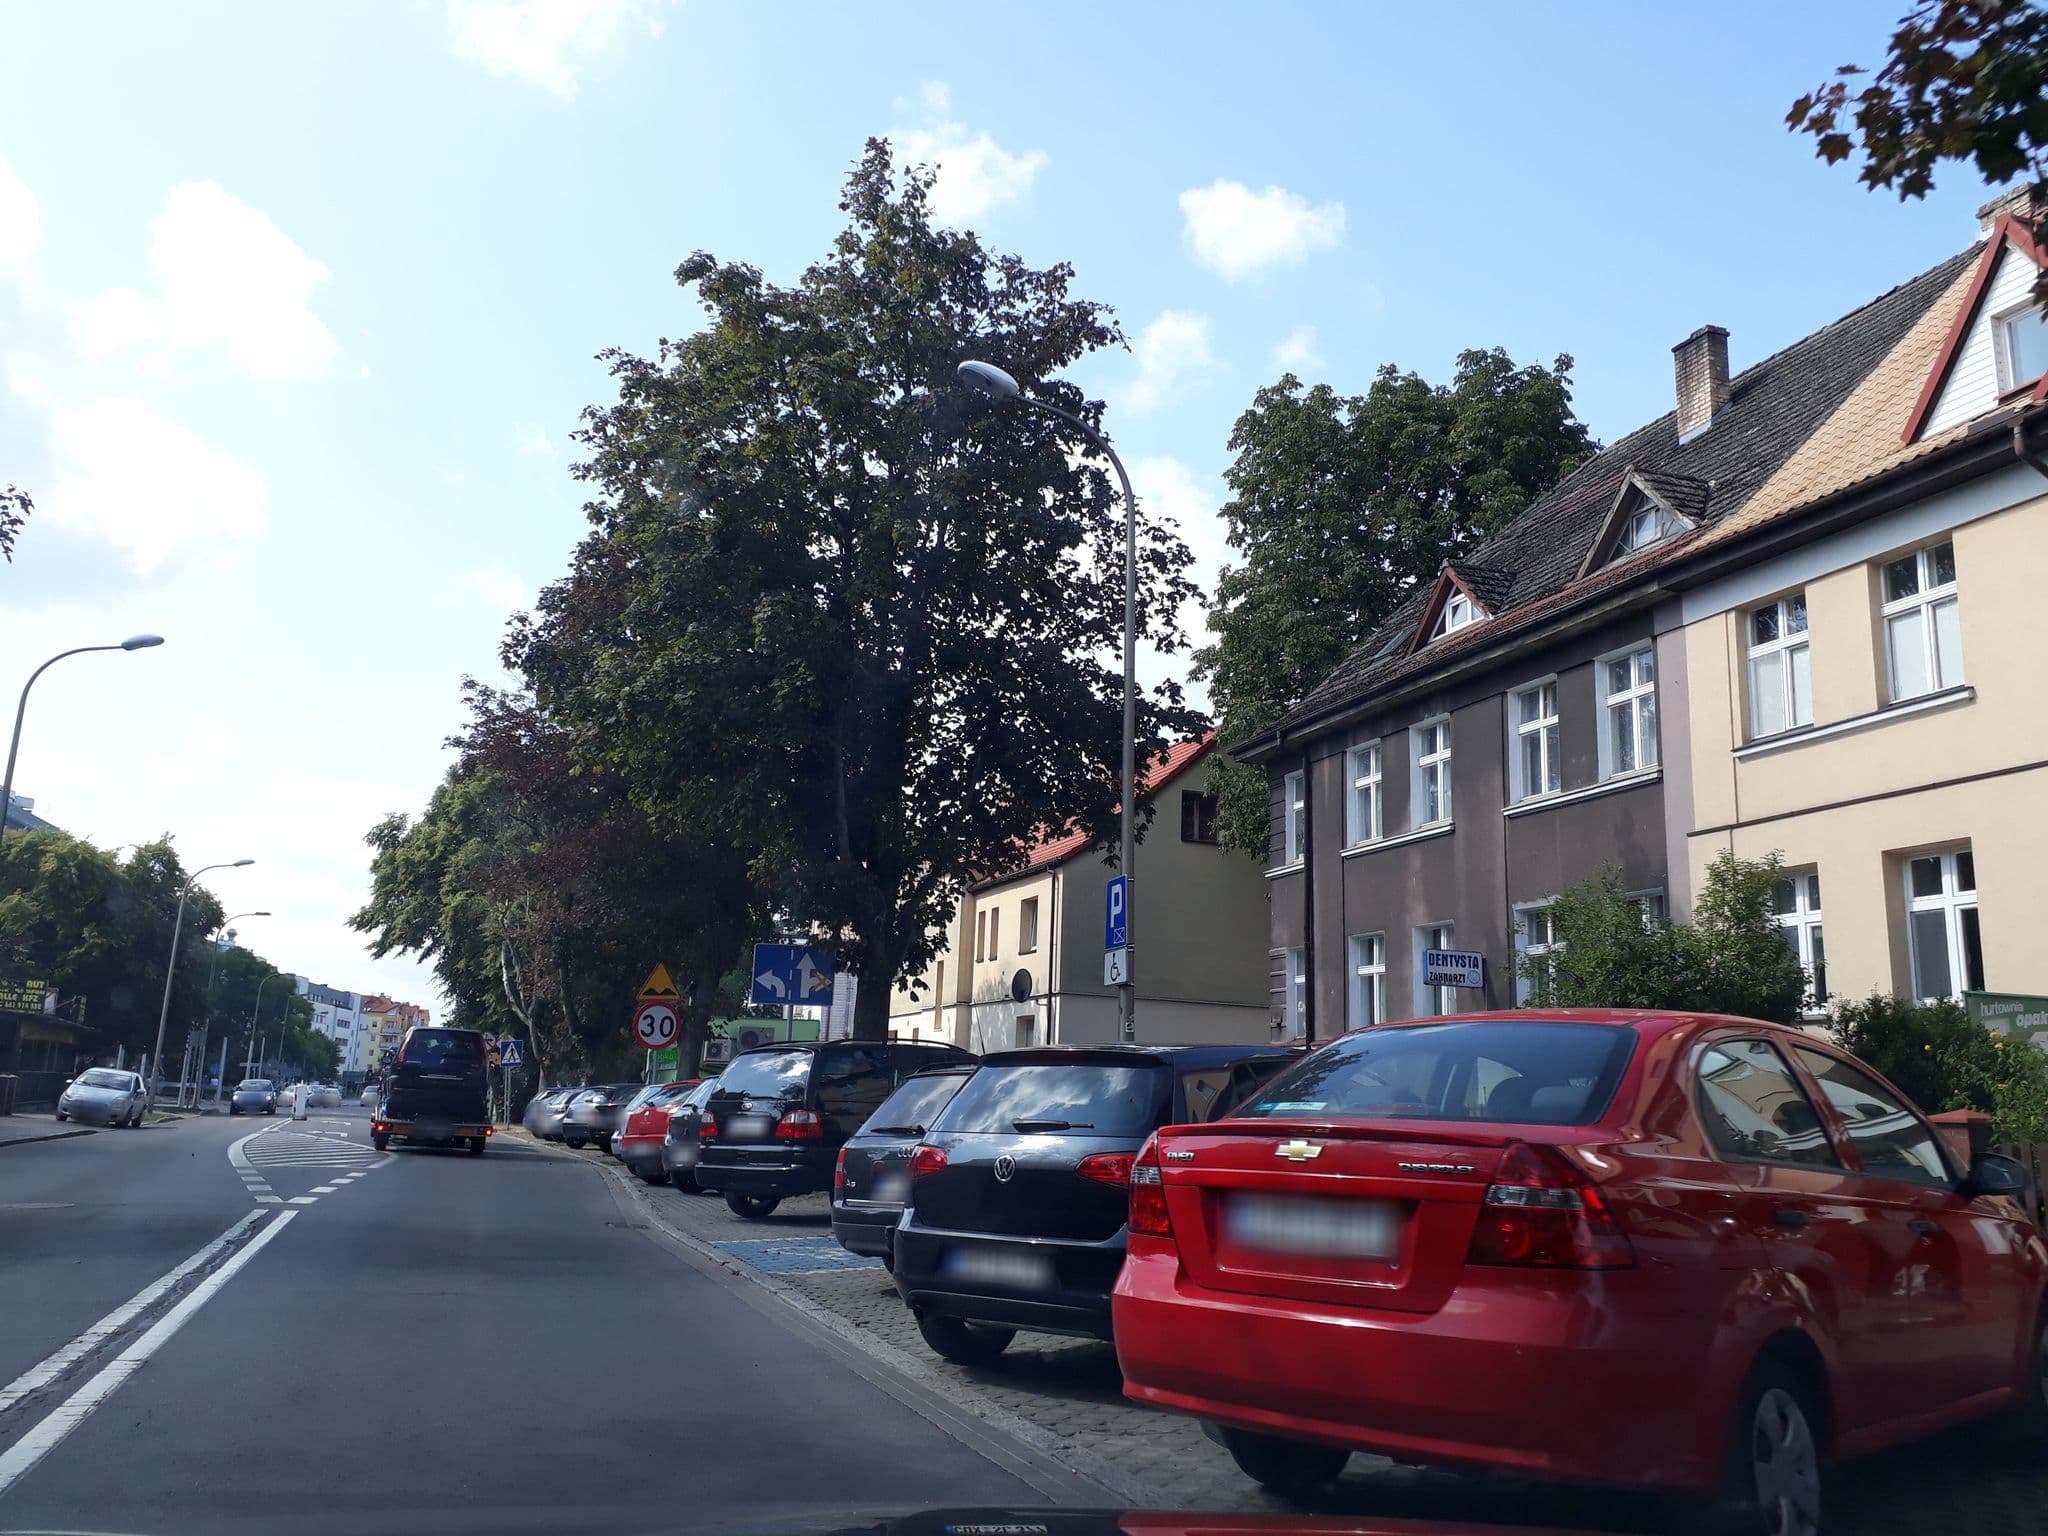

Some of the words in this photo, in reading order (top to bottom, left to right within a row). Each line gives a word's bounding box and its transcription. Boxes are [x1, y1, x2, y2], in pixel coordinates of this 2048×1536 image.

[1110, 884, 1123, 929] P
[1428, 953, 1479, 970] DENTYSTA
[1429, 971, 1466, 983] ZAHNARZT
[1980, 1001, 2024, 1017] hurtownia
[641, 1014, 675, 1038] 30
[1398, 1162, 1476, 1175] CHEVROLET
